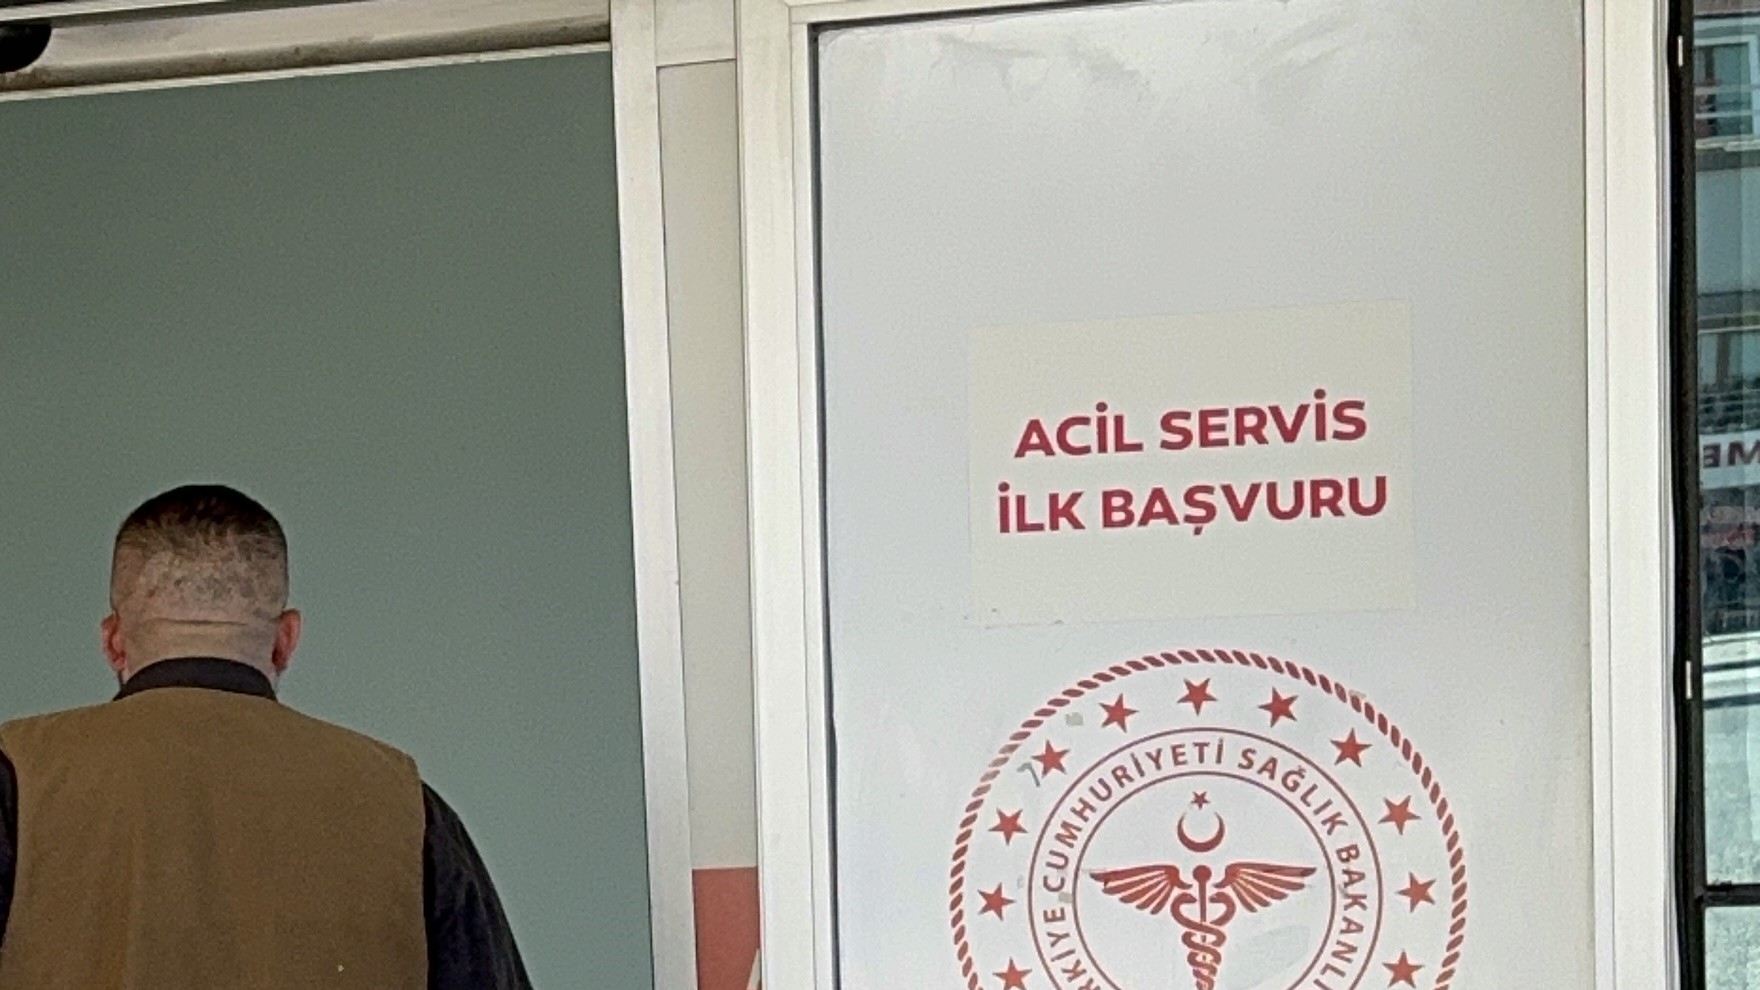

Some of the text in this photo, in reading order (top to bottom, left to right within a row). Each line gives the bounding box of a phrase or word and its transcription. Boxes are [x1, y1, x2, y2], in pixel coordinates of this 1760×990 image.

[1014, 388, 1368, 458] ACİL SERVİS
[998, 476, 1388, 536] İLK BAŞVURU
[1043, 738, 1224, 892] CUMHURİYETİ
[1238, 747, 1348, 835] SAĞLIK
